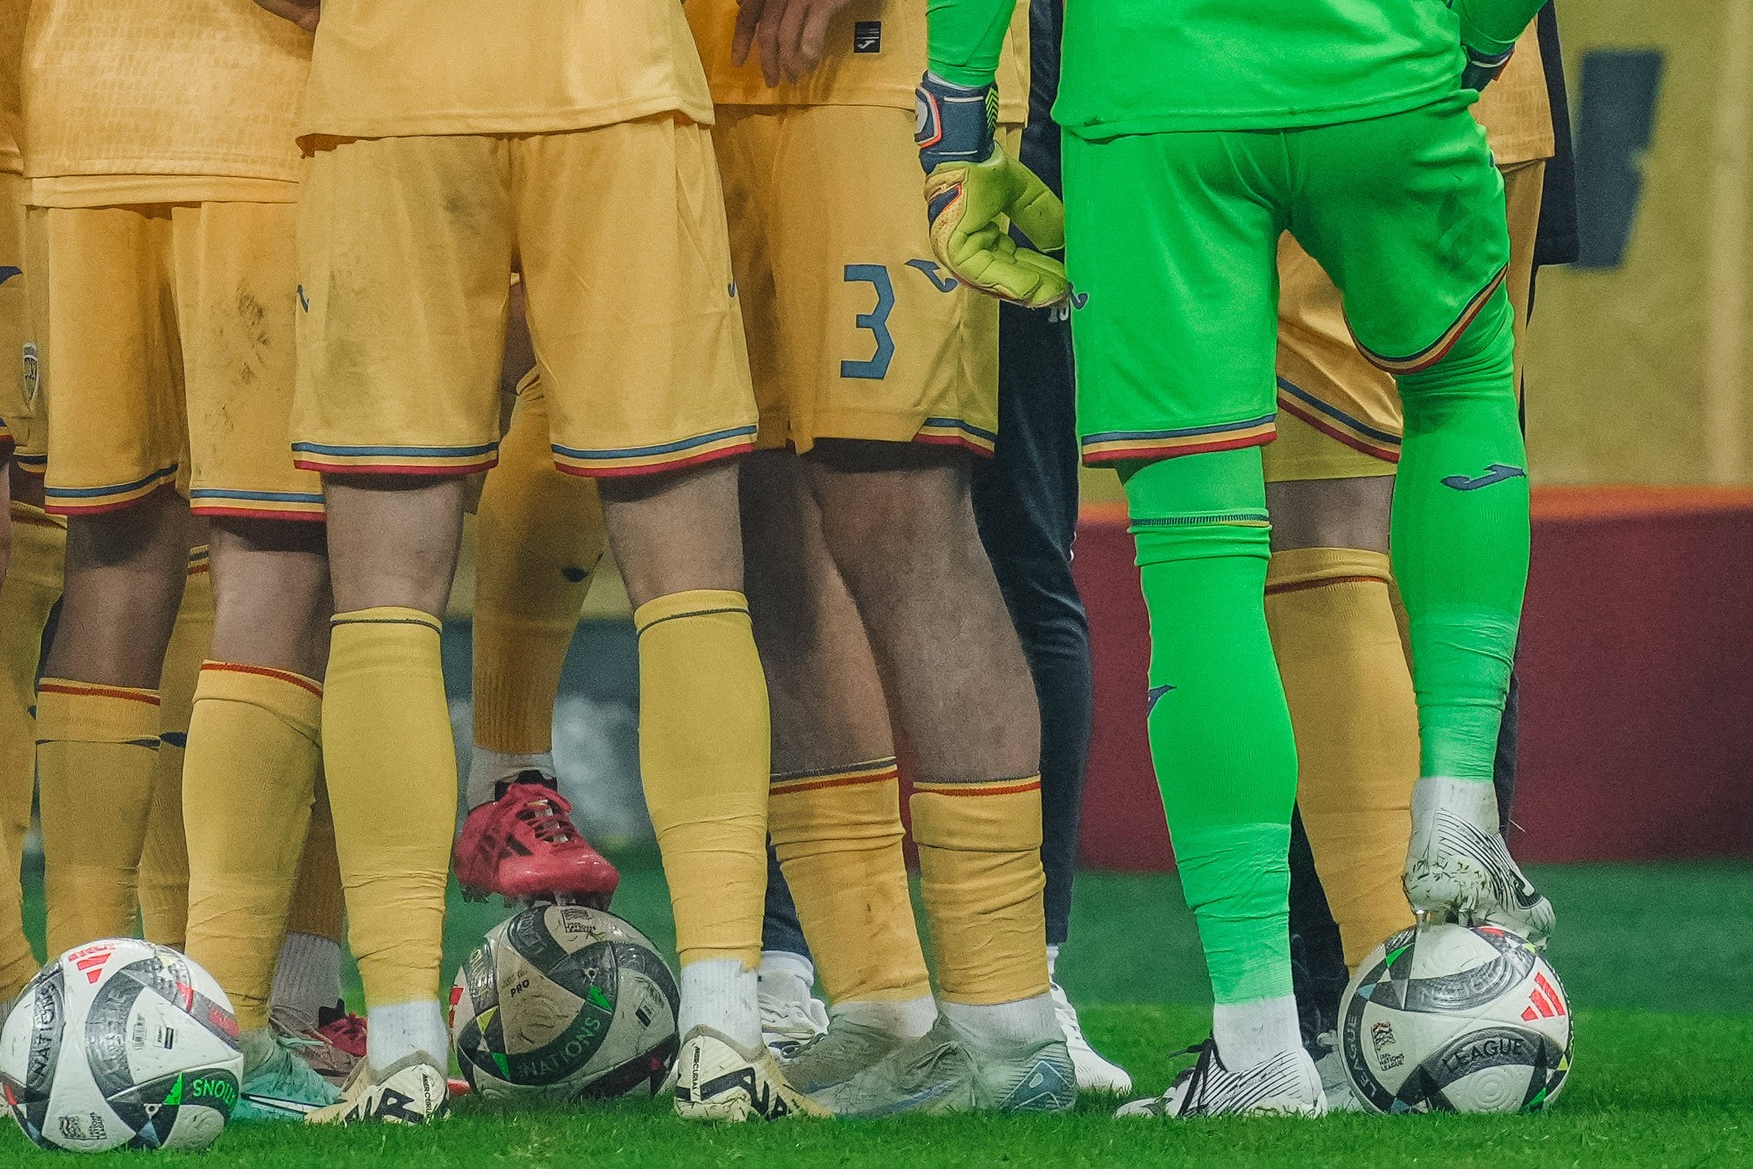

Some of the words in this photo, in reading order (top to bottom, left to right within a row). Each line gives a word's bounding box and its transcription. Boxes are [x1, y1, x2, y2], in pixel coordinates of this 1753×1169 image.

[840, 264, 896, 380] 3
[510, 979, 530, 998] PRO
[517, 1017, 601, 1078] NATIONS
[1346, 1014, 1377, 1098] LEAGUE
[1441, 1038, 1524, 1073] LEAGUE
